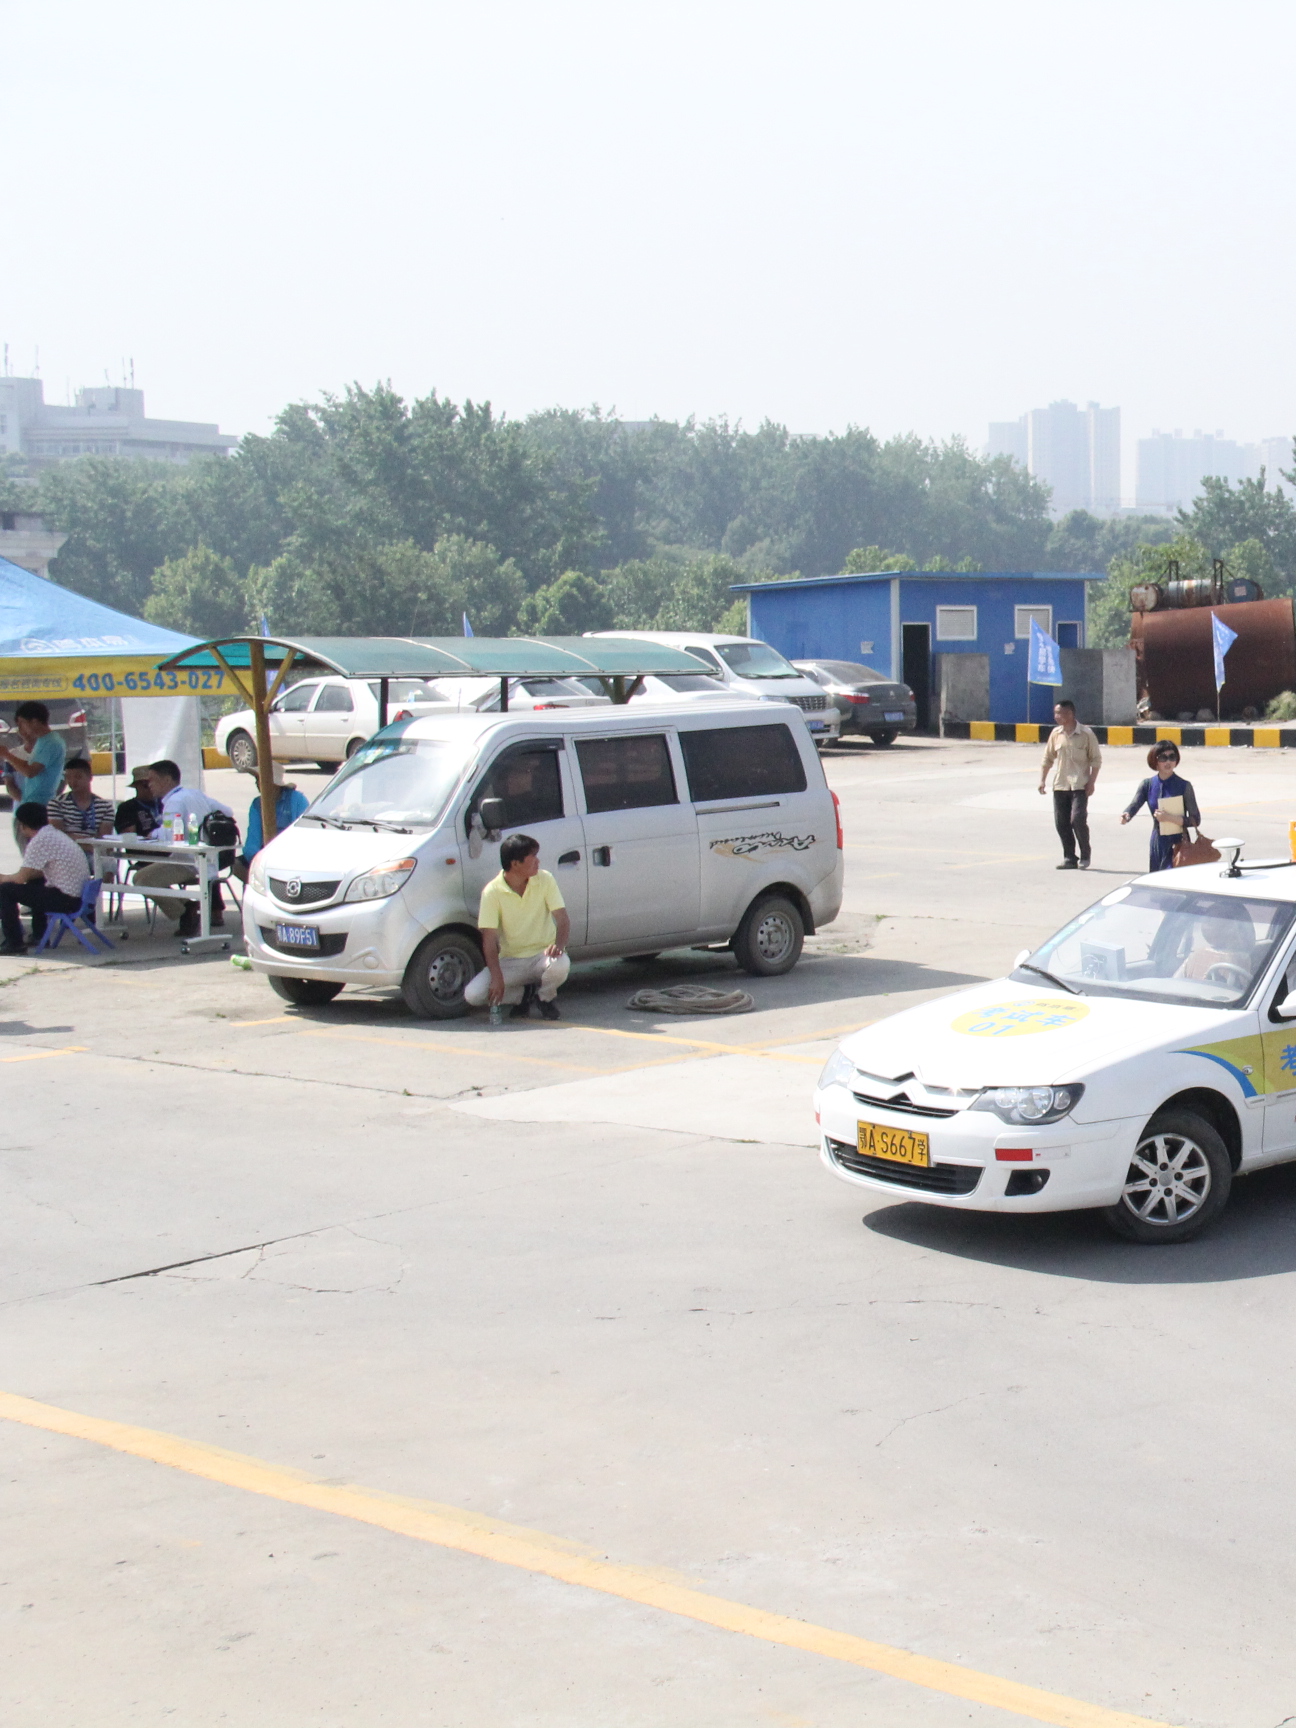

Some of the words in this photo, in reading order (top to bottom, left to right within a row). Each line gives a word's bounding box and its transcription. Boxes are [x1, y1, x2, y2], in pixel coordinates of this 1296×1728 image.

[72, 671, 226, 691] 400-6543-027
[972, 1007, 1077, 1026] 考试车
[968, 1021, 1016, 1035] 01
